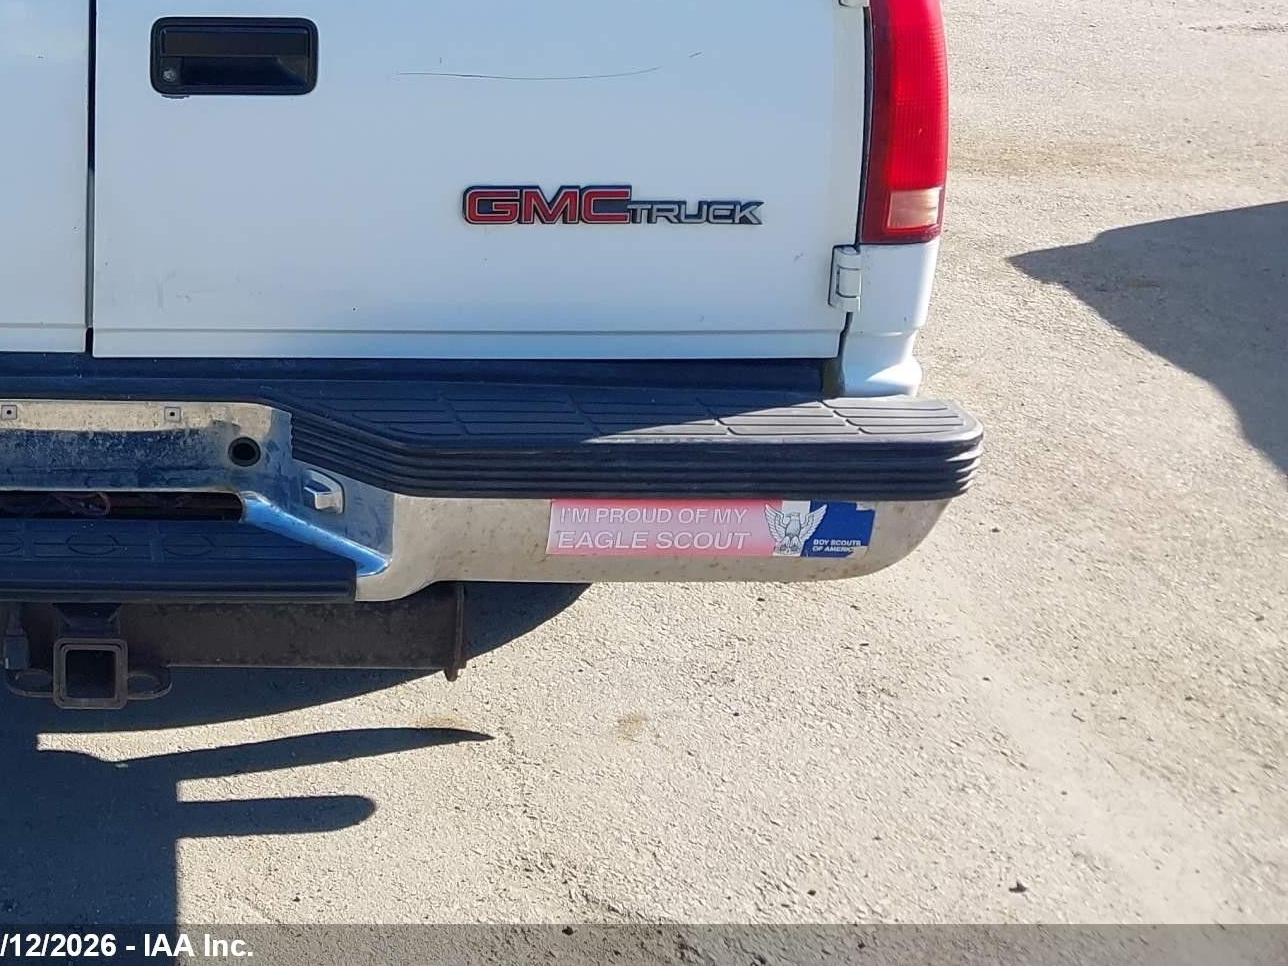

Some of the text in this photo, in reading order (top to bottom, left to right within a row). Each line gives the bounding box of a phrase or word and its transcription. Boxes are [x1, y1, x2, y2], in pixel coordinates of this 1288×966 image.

[462, 185, 765, 225] GMC TRUCK
[559, 507, 749, 524] I'M PROUD OF MY
[557, 531, 752, 550] EAGLE SCOUT
[830, 539, 862, 547] SCOUTS
